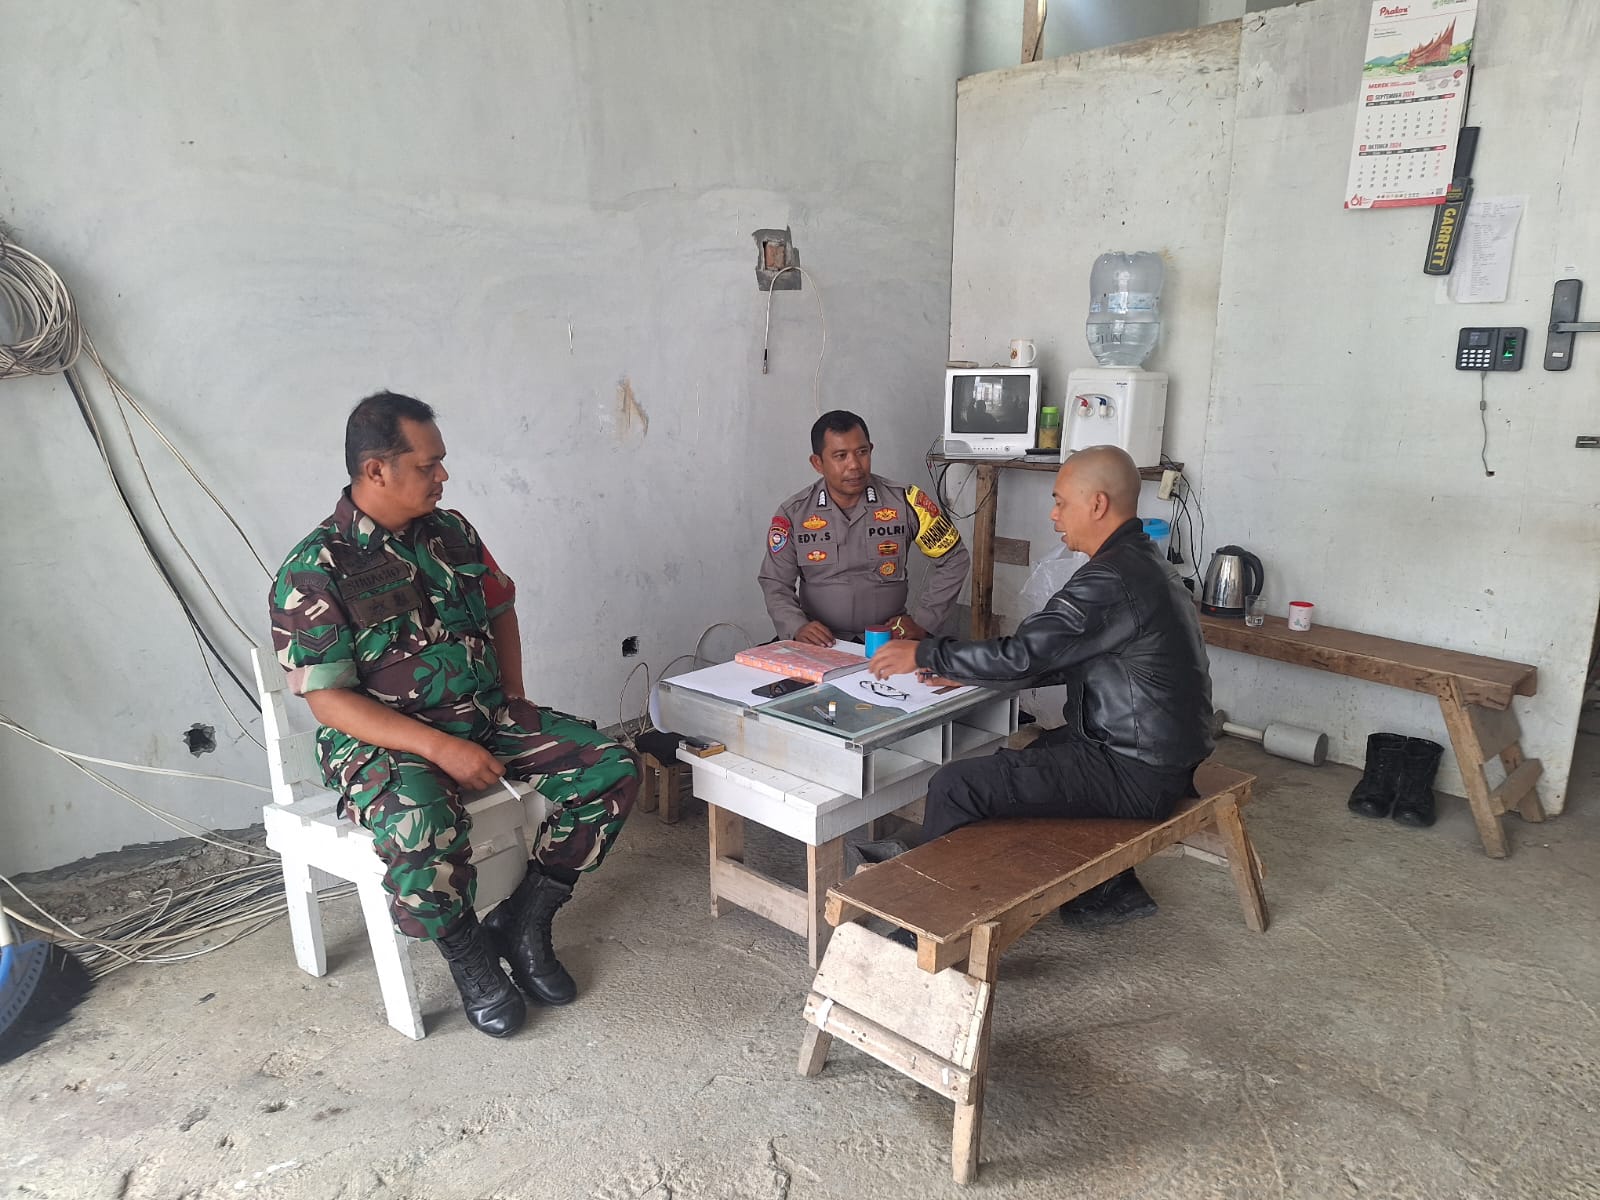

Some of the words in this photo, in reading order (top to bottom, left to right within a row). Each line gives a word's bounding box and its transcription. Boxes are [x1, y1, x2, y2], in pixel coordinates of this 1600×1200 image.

[1432, 208, 1457, 266] GARRETT
[869, 525, 905, 537] POLRI
[798, 533, 817, 544] EDY
